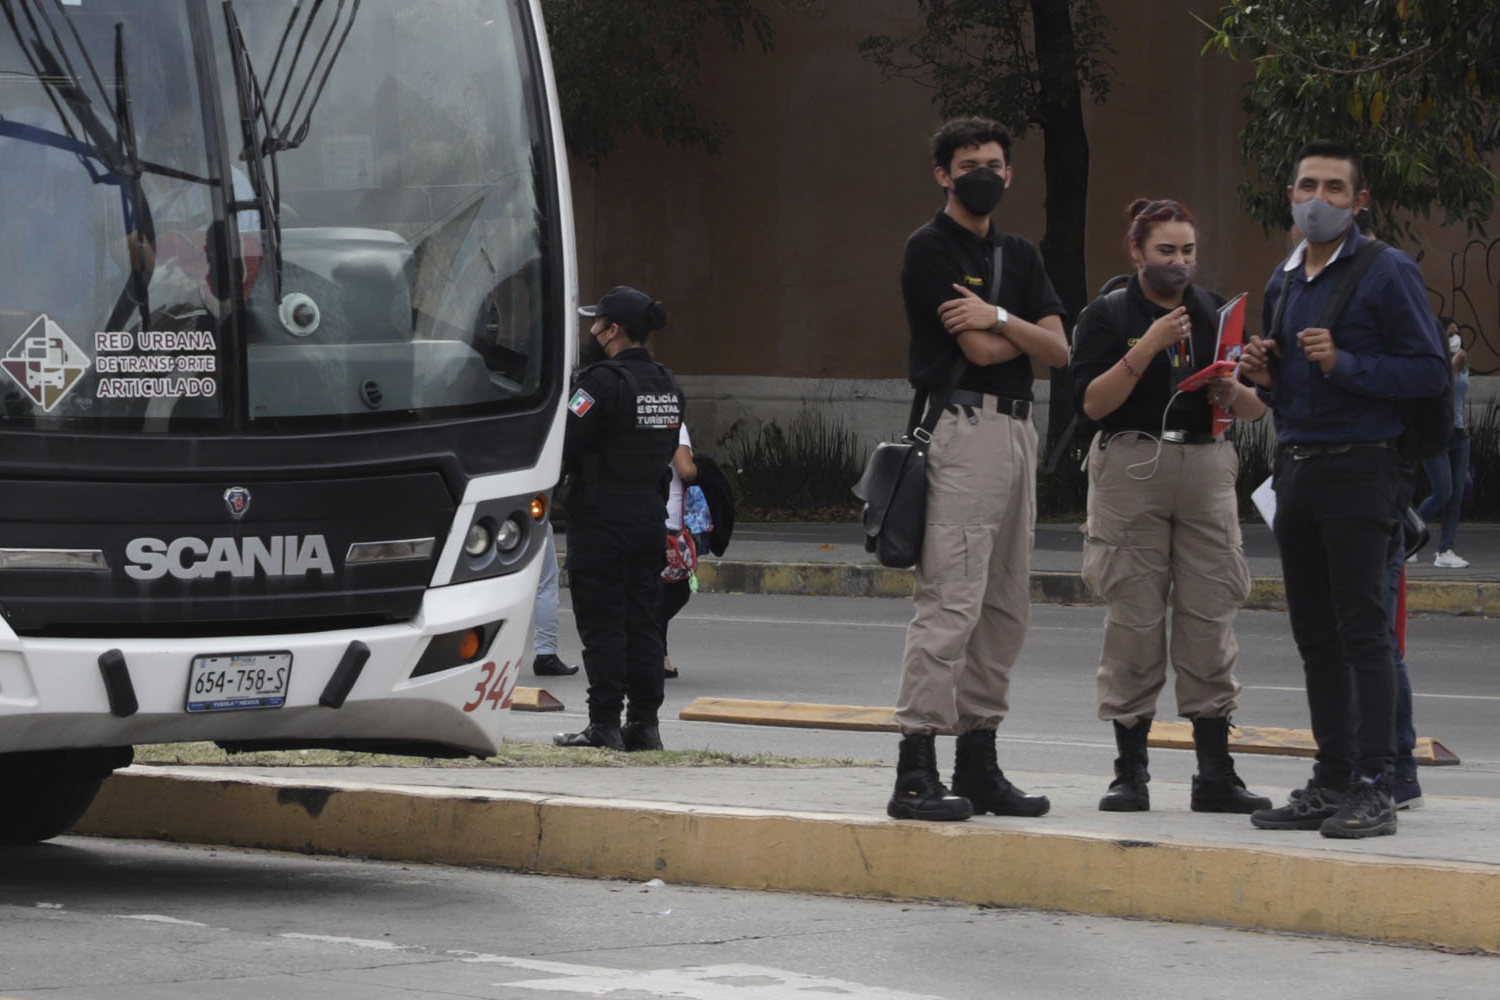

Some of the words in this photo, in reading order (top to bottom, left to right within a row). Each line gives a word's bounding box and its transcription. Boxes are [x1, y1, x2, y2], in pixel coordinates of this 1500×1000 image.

[95, 331, 134, 351] RED
[138, 330, 217, 351] URBANA
[96, 356, 119, 373] DE
[119, 355, 216, 373] TRANSPORTE
[97, 378, 217, 398] ARTICULADO
[637, 404, 680, 414] ESTATAL
[123, 534, 336, 581] SCANIA
[194, 667, 287, 695] 654-758-S
